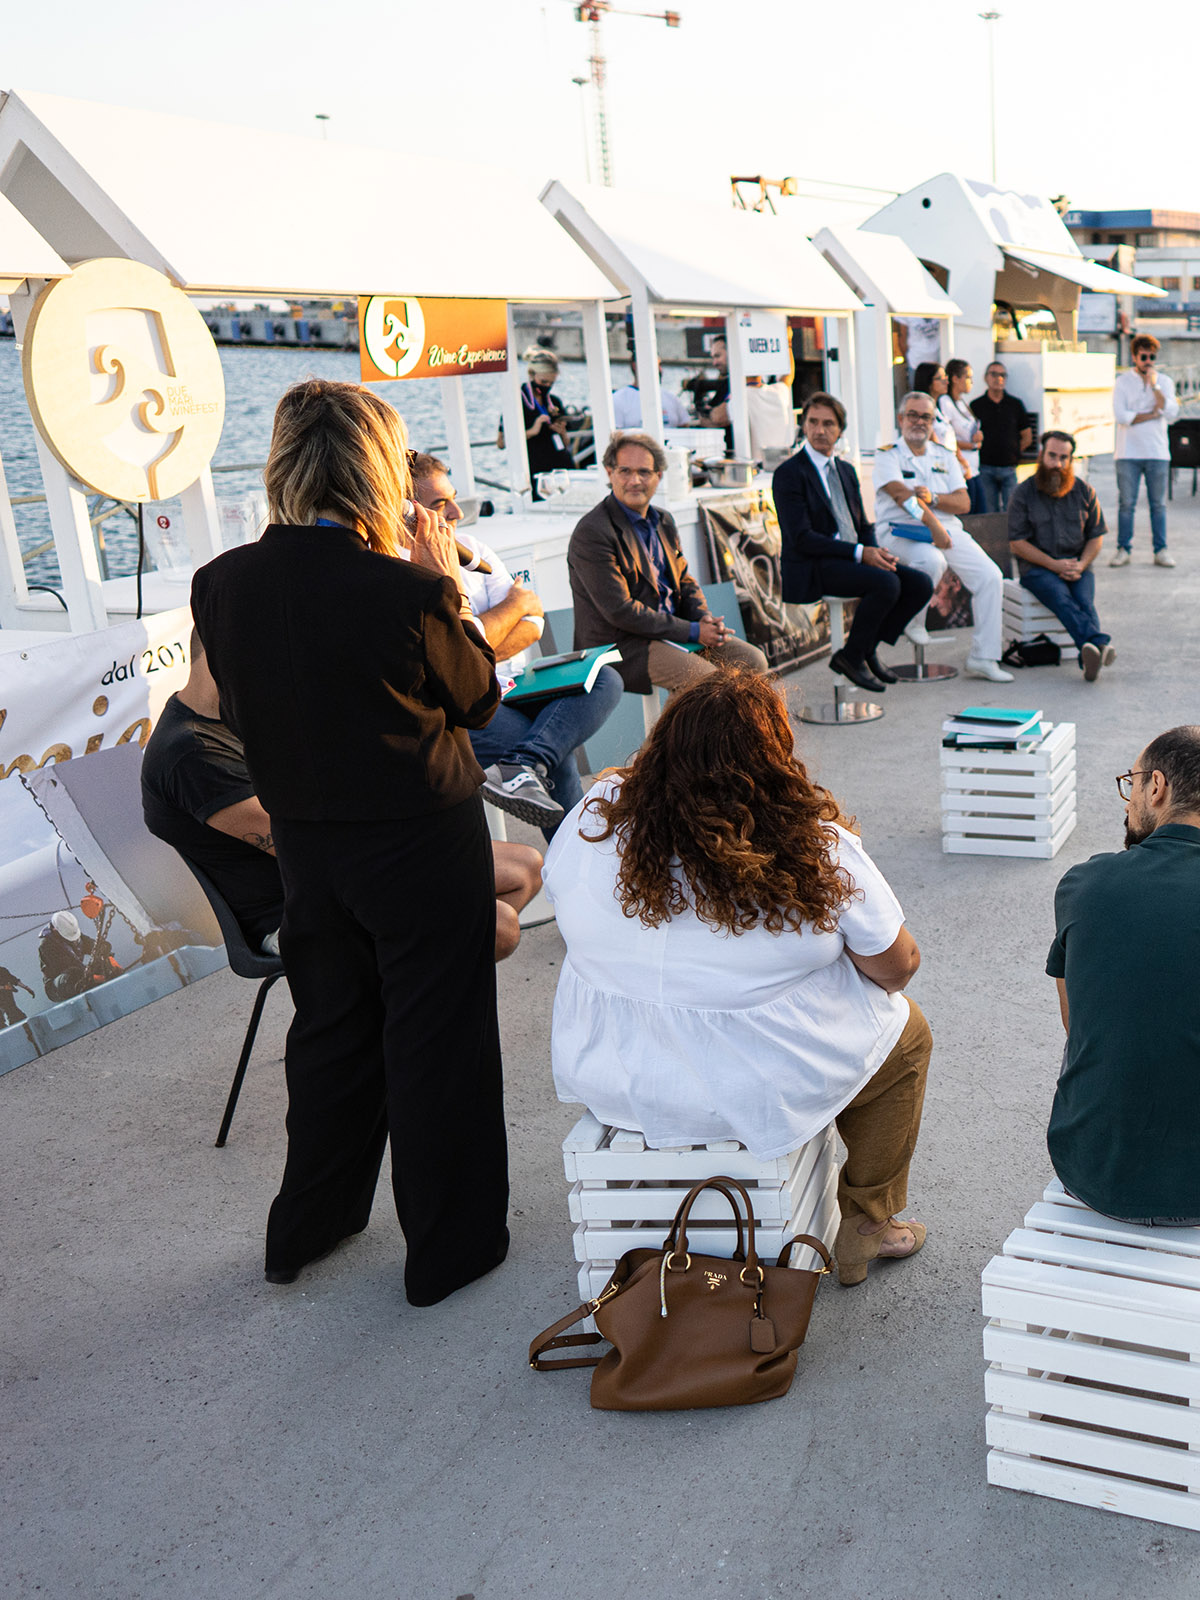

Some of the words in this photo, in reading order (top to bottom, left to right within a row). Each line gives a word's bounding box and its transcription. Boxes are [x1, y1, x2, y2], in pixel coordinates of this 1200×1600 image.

[428, 344, 457, 367] Wine
[457, 344, 507, 369] Experience
[167, 386, 188, 397] DUE
[168, 394, 193, 406] MARI
[170, 403, 218, 416] WINEFEST
[101, 655, 135, 686] dal
[704, 1271, 727, 1280] PRADA
